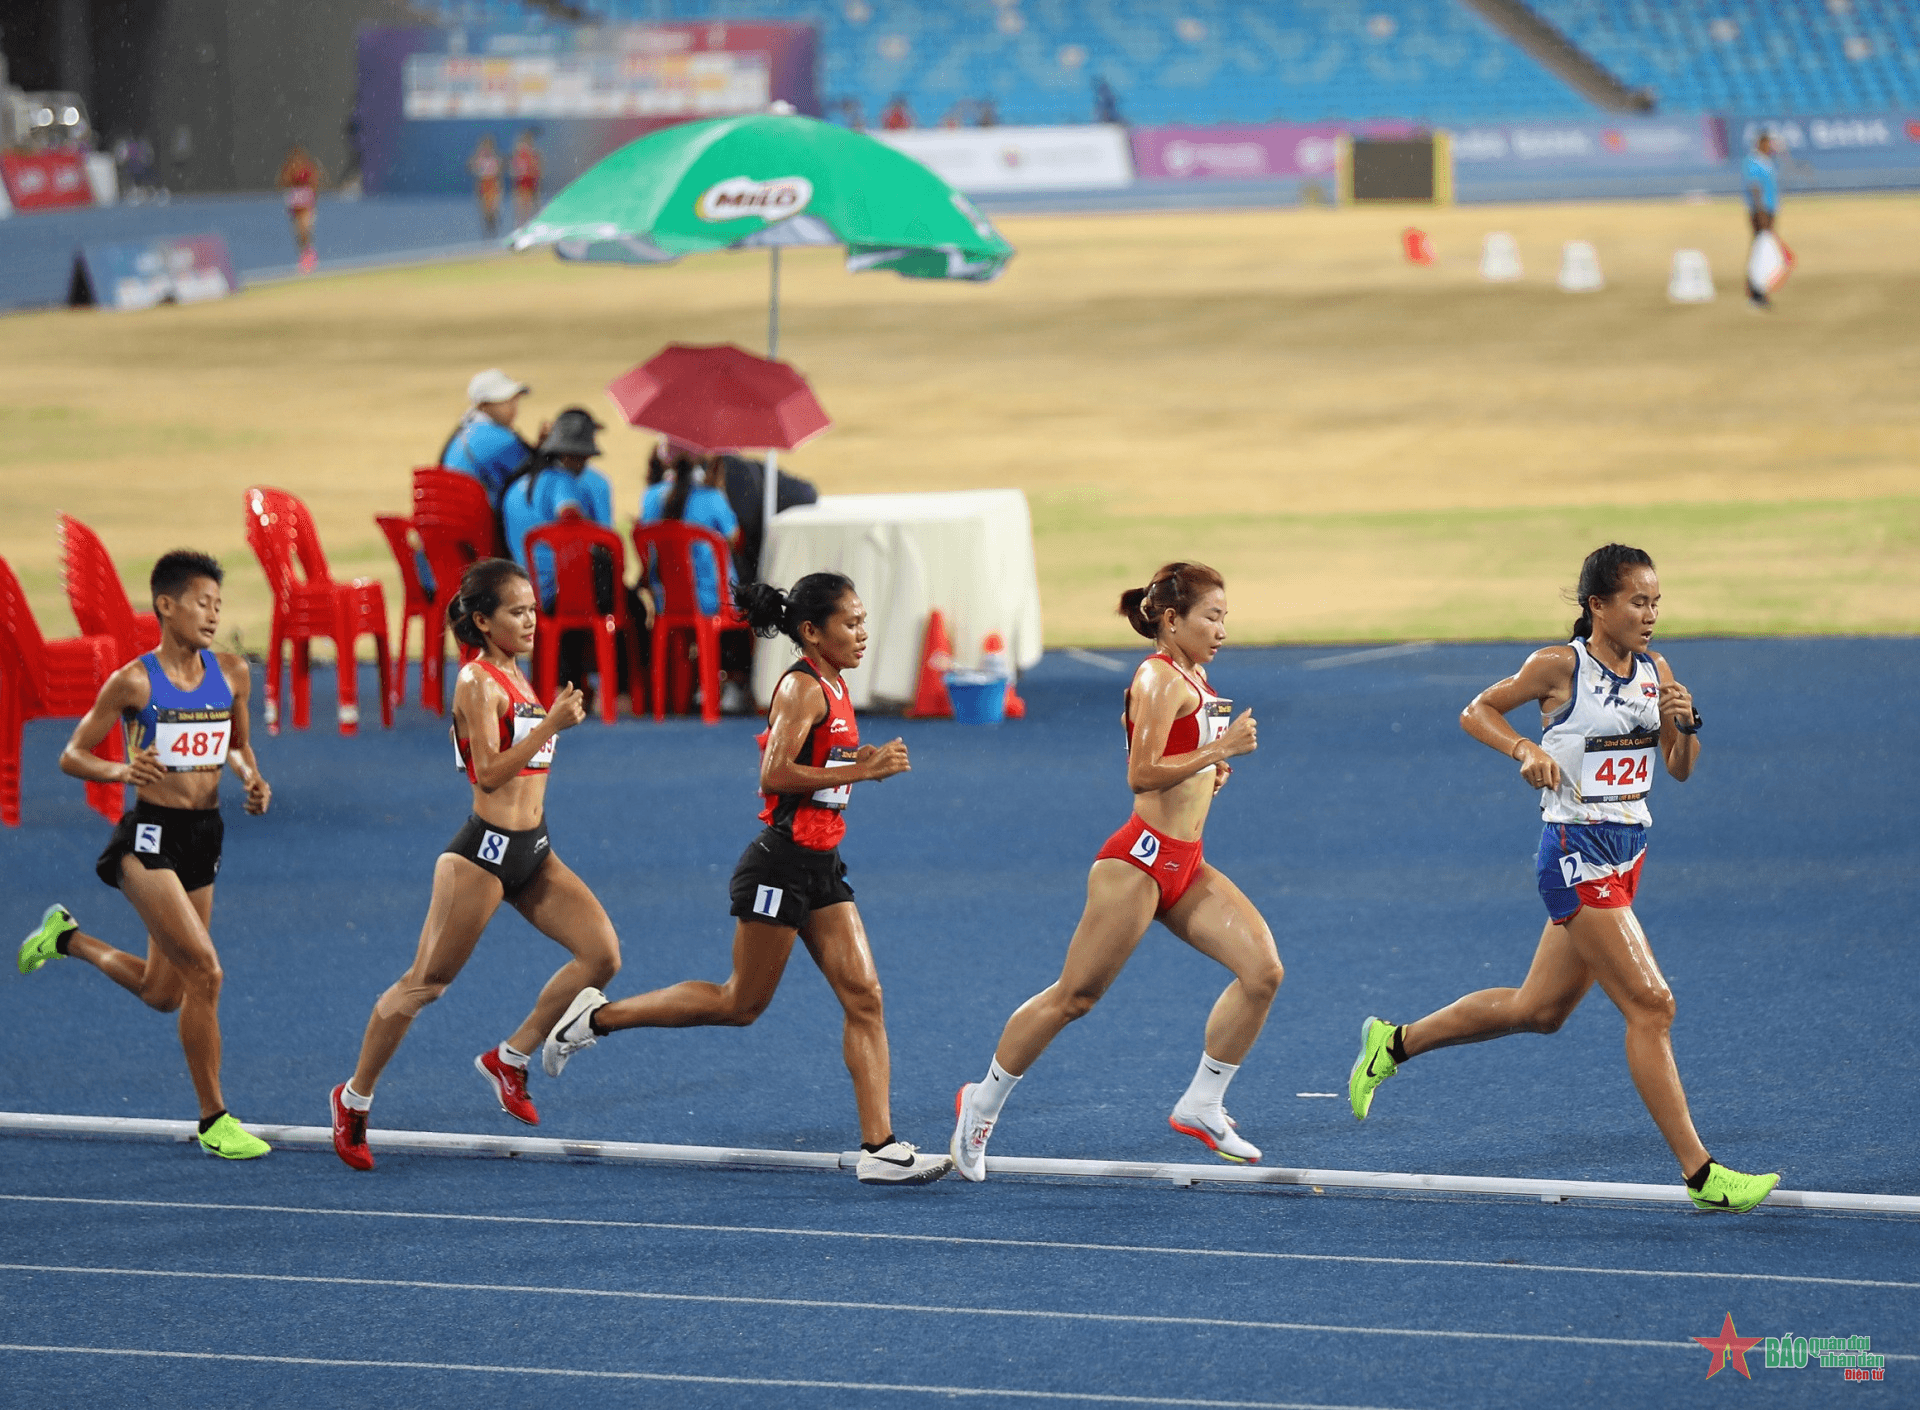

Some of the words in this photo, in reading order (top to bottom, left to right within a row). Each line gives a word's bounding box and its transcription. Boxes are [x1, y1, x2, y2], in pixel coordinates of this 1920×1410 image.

[715, 187, 798, 206] MILO
[171, 732, 225, 756] 487
[1619, 738, 1633, 746] SEA
[1595, 754, 1648, 786] 424
[140, 826, 156, 852] 5
[483, 834, 503, 860] 8
[1133, 835, 1156, 858] 9
[1564, 856, 1582, 885] 2
[762, 889, 774, 914] 1
